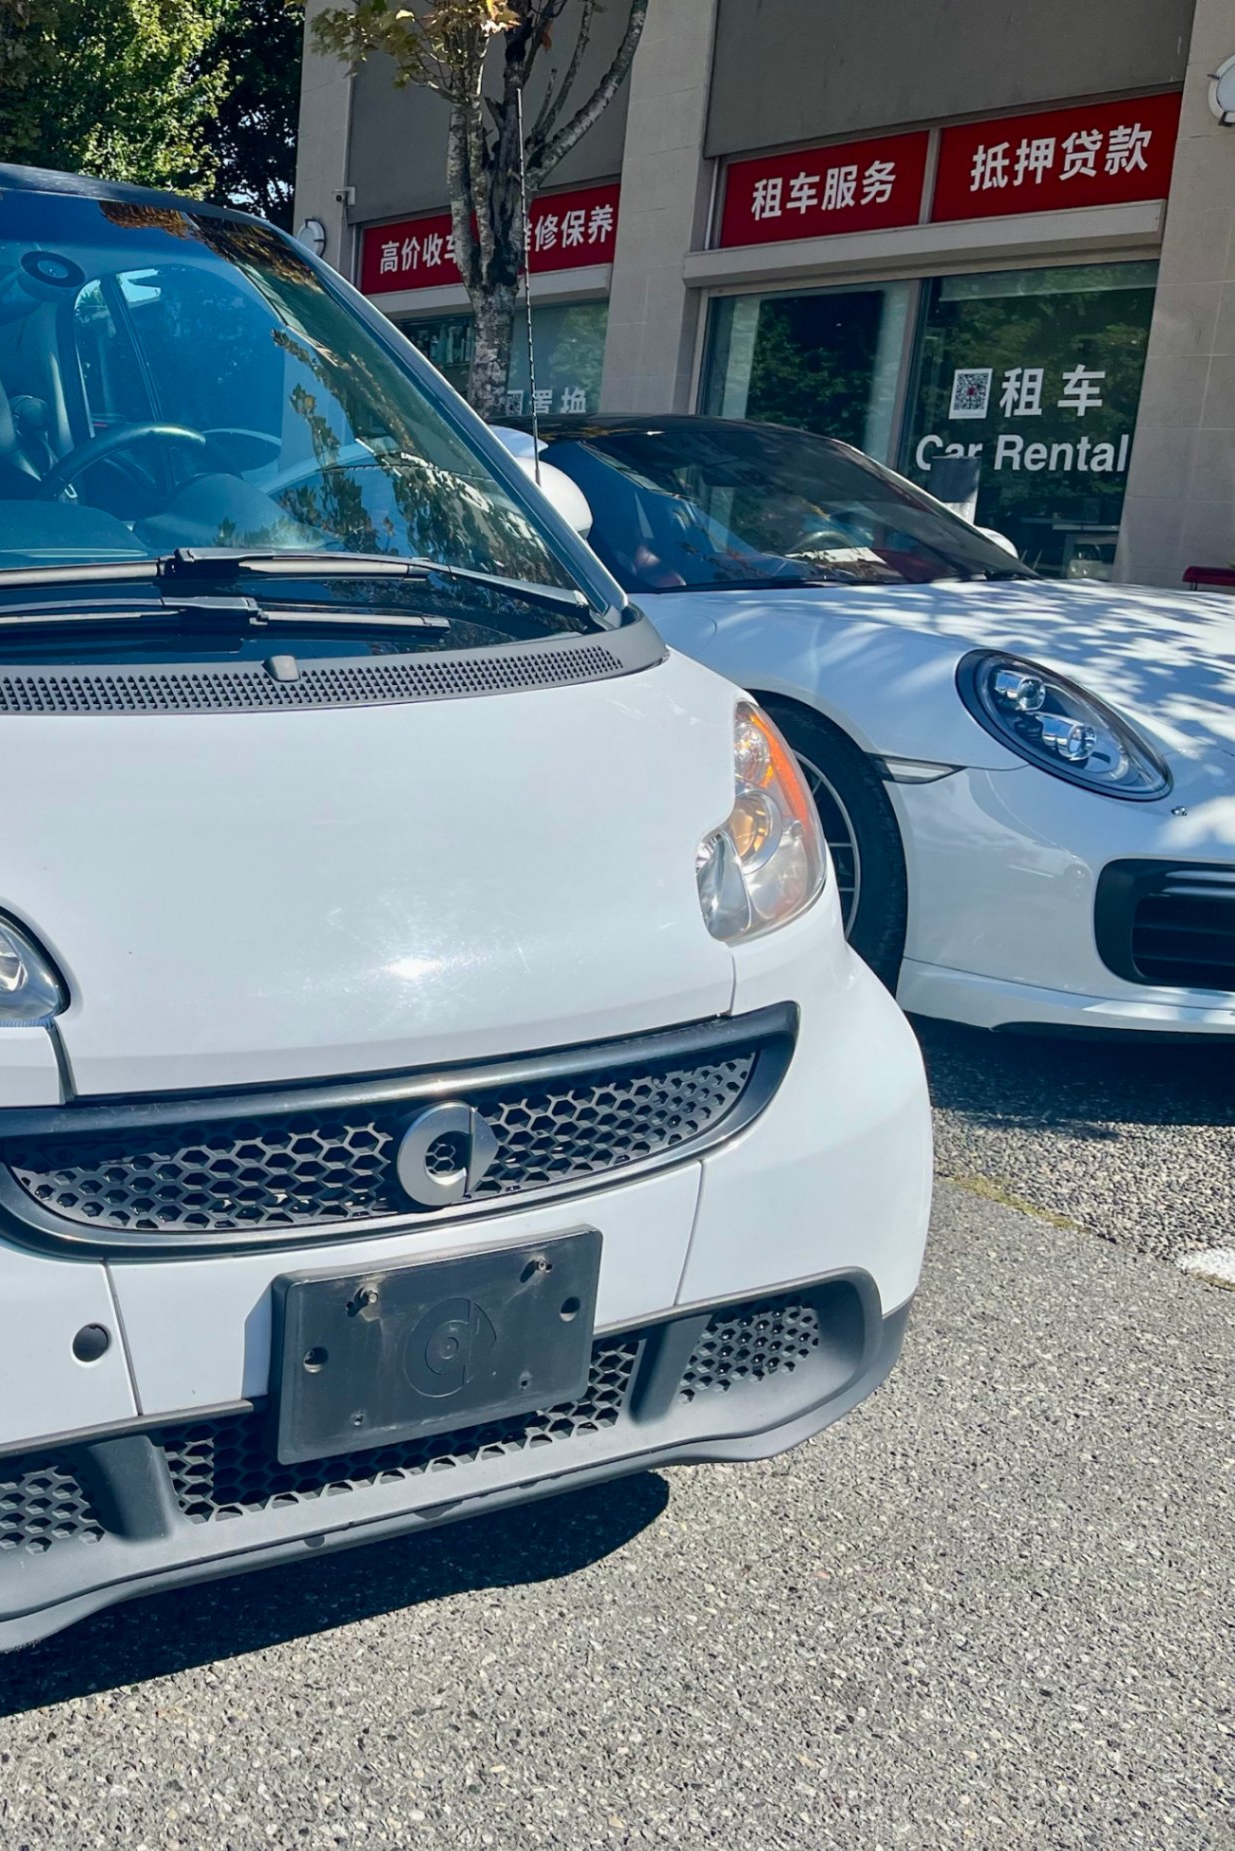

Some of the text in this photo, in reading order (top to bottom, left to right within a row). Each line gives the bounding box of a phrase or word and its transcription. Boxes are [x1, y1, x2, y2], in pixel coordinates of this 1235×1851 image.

[969, 122, 1153, 192] 抵押贷款
[751, 160, 896, 221] 租车服务
[999, 363, 1106, 418] 租车
[994, 434, 1130, 472] Rental
